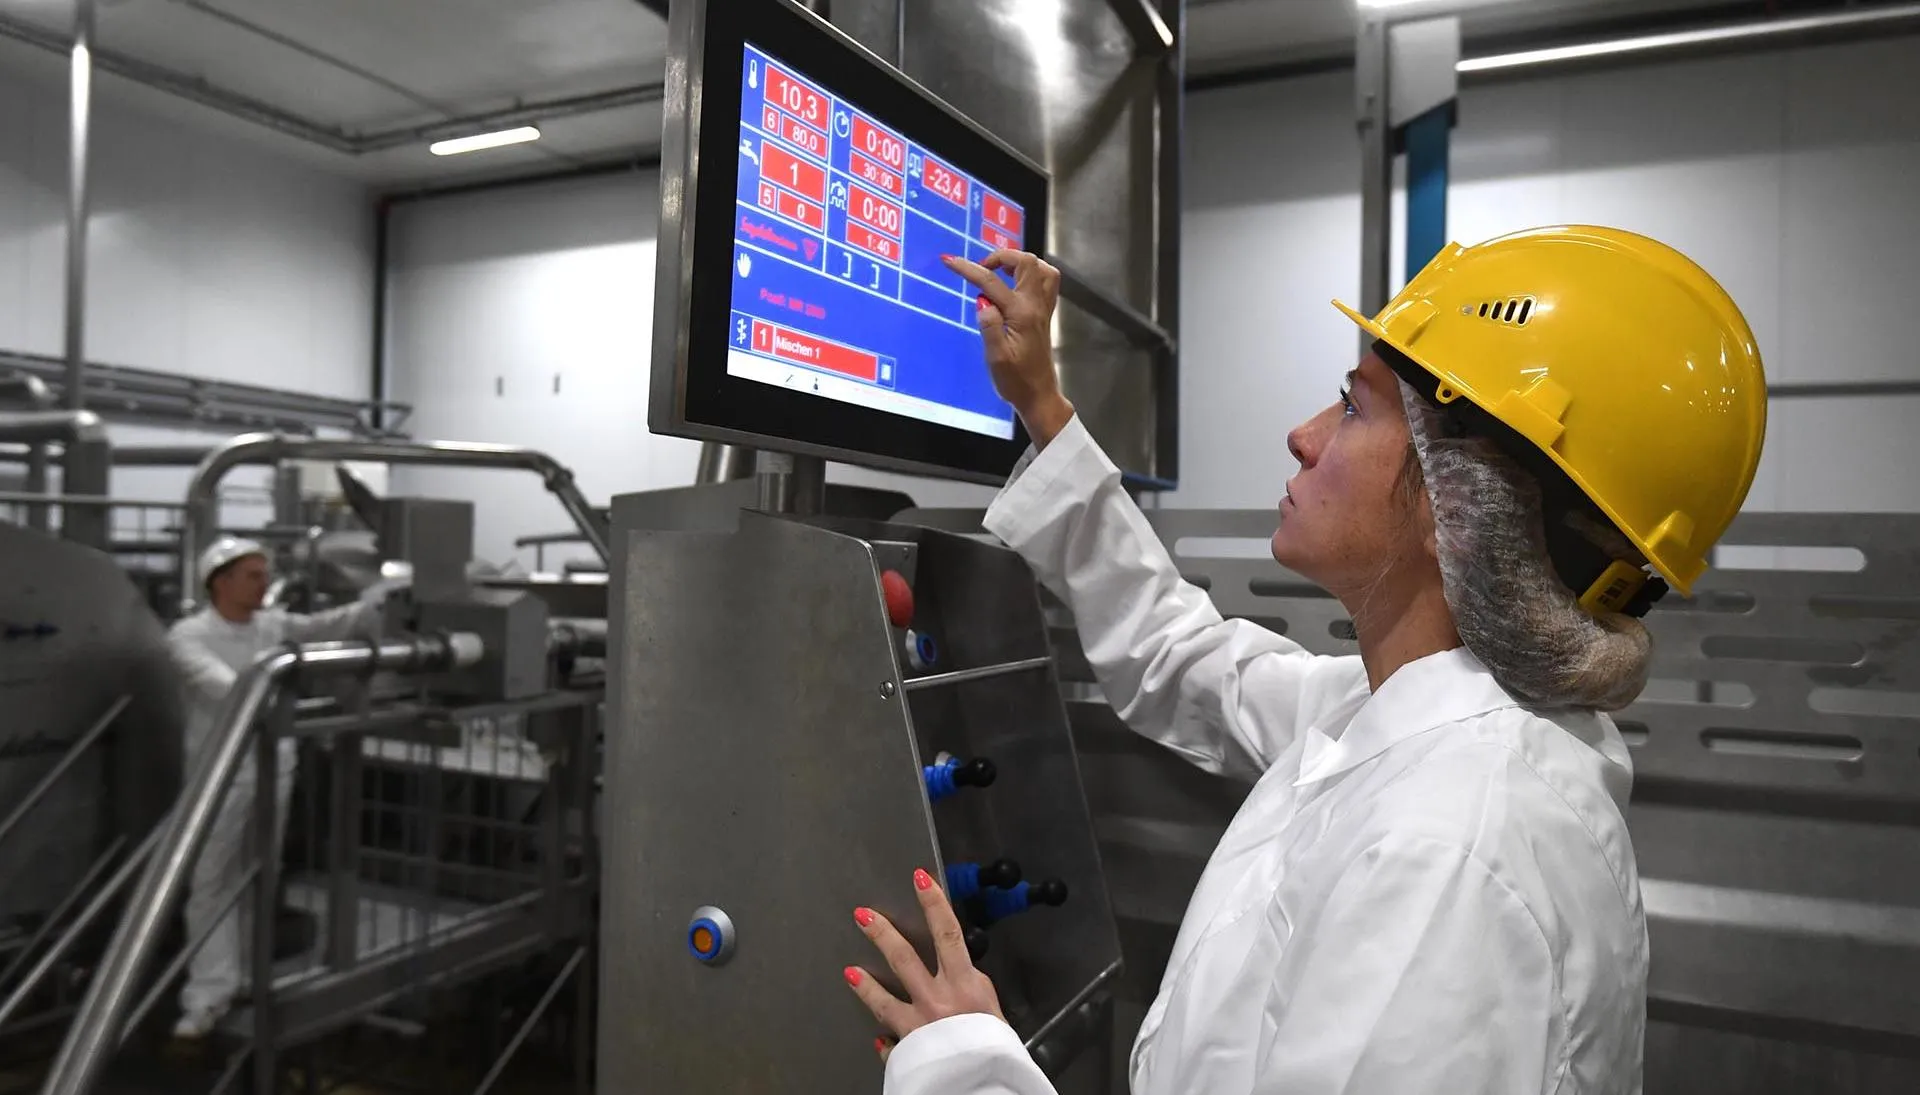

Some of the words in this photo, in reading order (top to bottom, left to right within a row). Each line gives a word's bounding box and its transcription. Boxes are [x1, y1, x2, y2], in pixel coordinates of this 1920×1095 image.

[780, 80, 817, 121] 10,3
[768, 112, 775, 129] 6
[792, 126, 817, 151] 80,0
[866, 130, 901, 165] 0:00
[789, 162, 798, 186] 1
[929, 168, 962, 201] -23,4
[763, 189, 771, 204] 5
[797, 204, 805, 219] 0
[863, 197, 898, 226] 0:00
[998, 206, 1007, 225] 0
[866, 235, 890, 255] 1:40
[760, 328, 767, 347] 1
[775, 335, 813, 357] Mischen
[815, 347, 820, 360] 1
